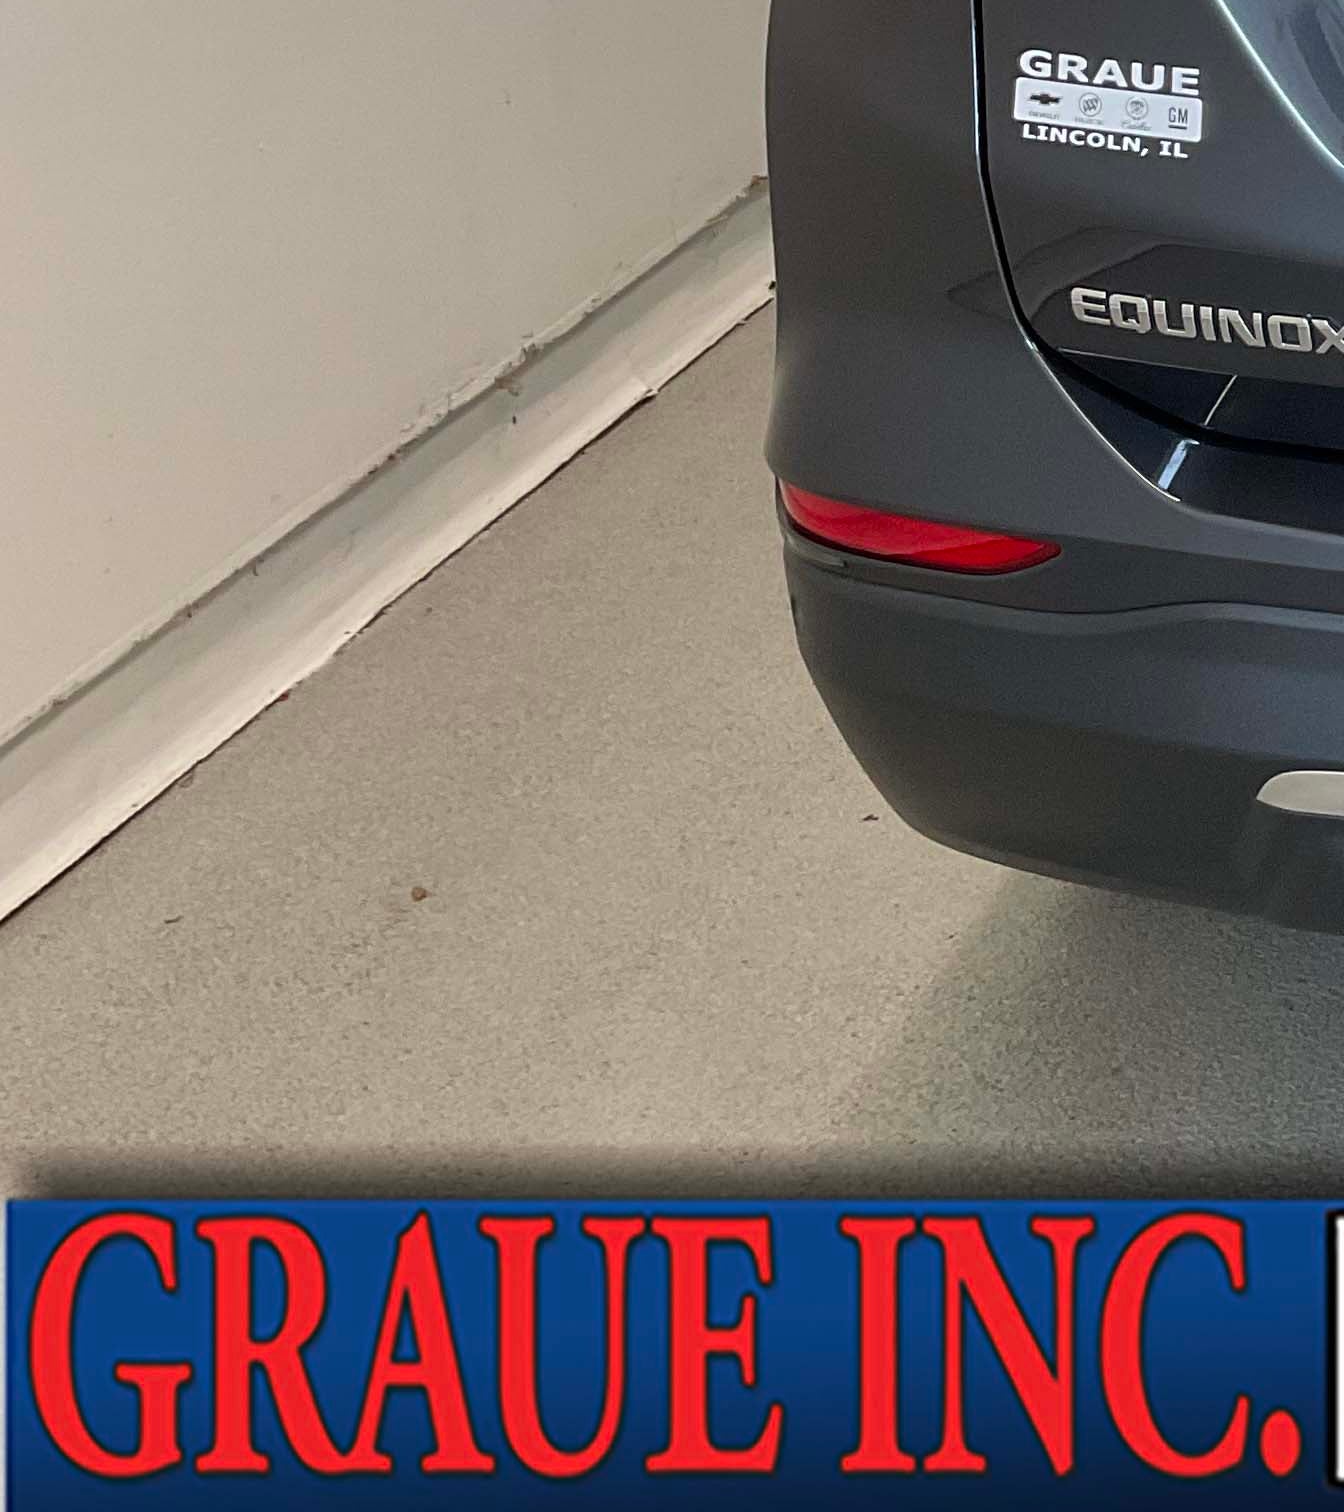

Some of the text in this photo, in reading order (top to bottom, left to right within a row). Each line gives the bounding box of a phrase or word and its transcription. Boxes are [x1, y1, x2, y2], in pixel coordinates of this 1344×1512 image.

[1019, 49, 1201, 96] GRAUE
[1168, 106, 1188, 124] GM
[1022, 123, 1149, 157] LINCOLN,
[1159, 141, 1189, 159] IL
